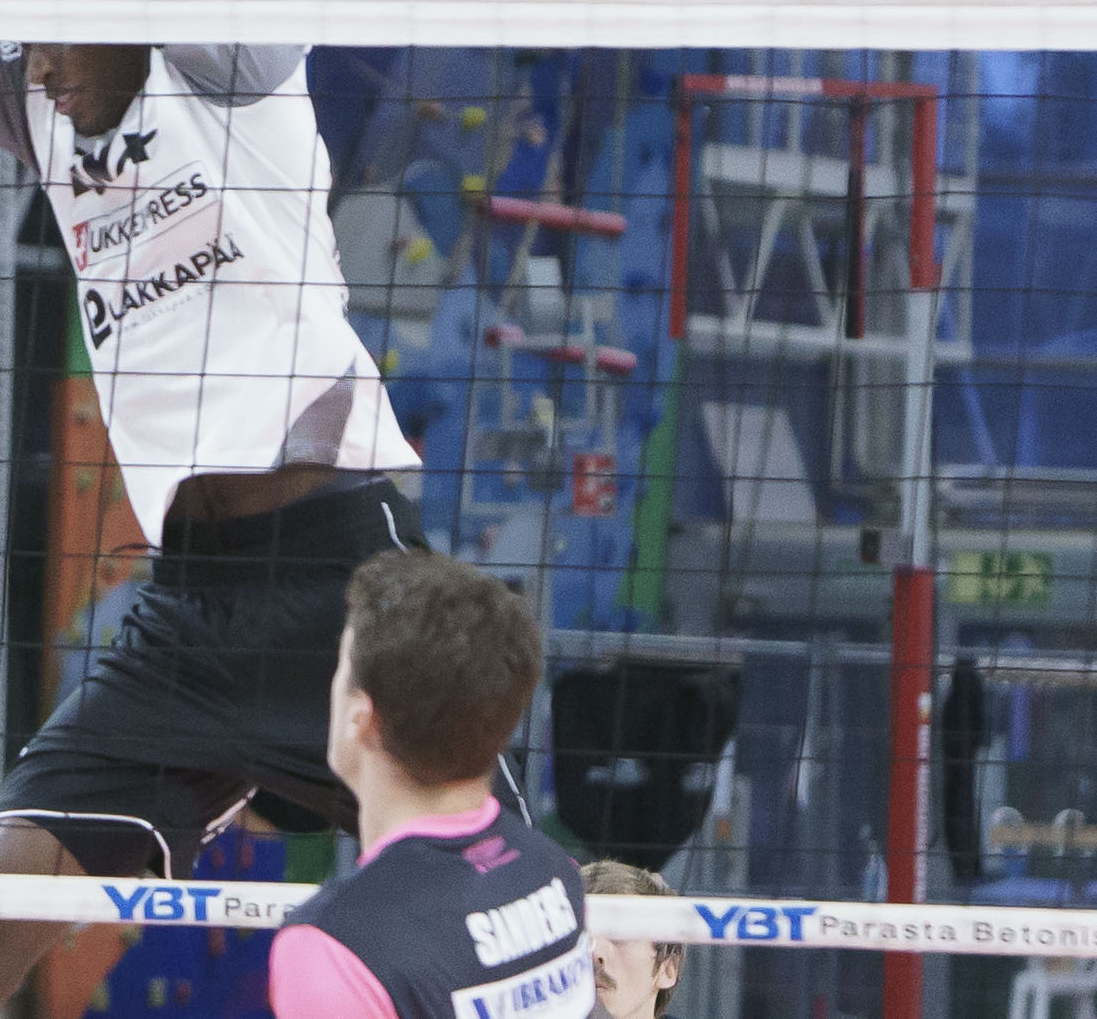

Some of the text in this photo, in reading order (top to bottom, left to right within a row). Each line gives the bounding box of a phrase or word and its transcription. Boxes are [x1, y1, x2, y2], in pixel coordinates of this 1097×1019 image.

[102, 884, 222, 922] YBT
[694, 903, 819, 941] YBT
[820, 914, 958, 941] Parasta
